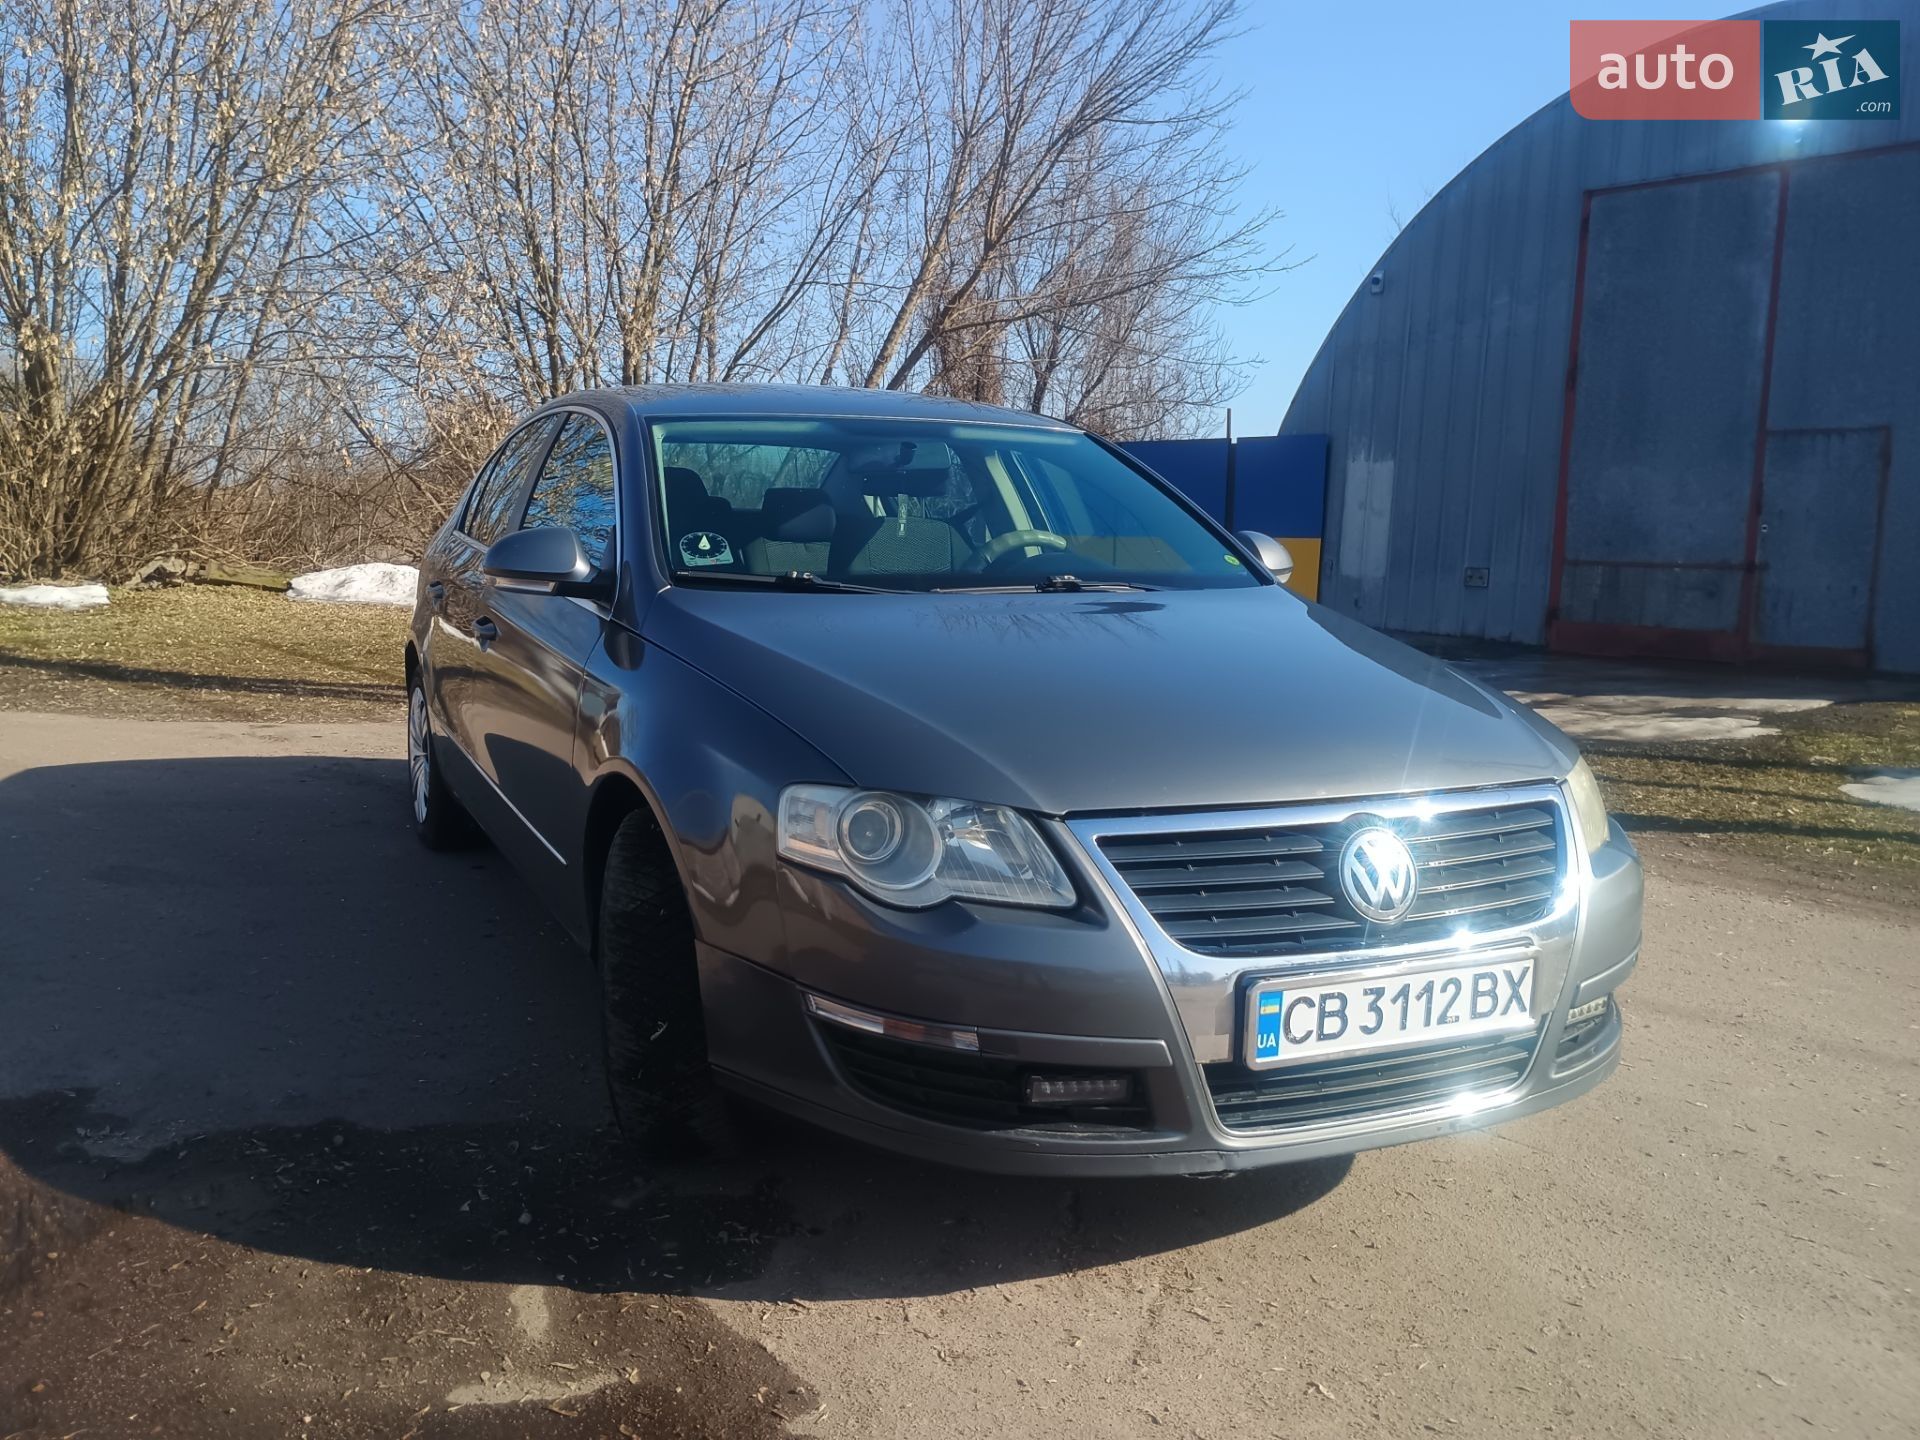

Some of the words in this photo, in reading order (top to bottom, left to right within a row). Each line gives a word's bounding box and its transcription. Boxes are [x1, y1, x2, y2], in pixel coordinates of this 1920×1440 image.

[1282, 991, 1349, 1045] CB
[1359, 978, 1461, 1035] 3112
[1470, 966, 1530, 1020] BX
[1257, 1033, 1277, 1048] UA
